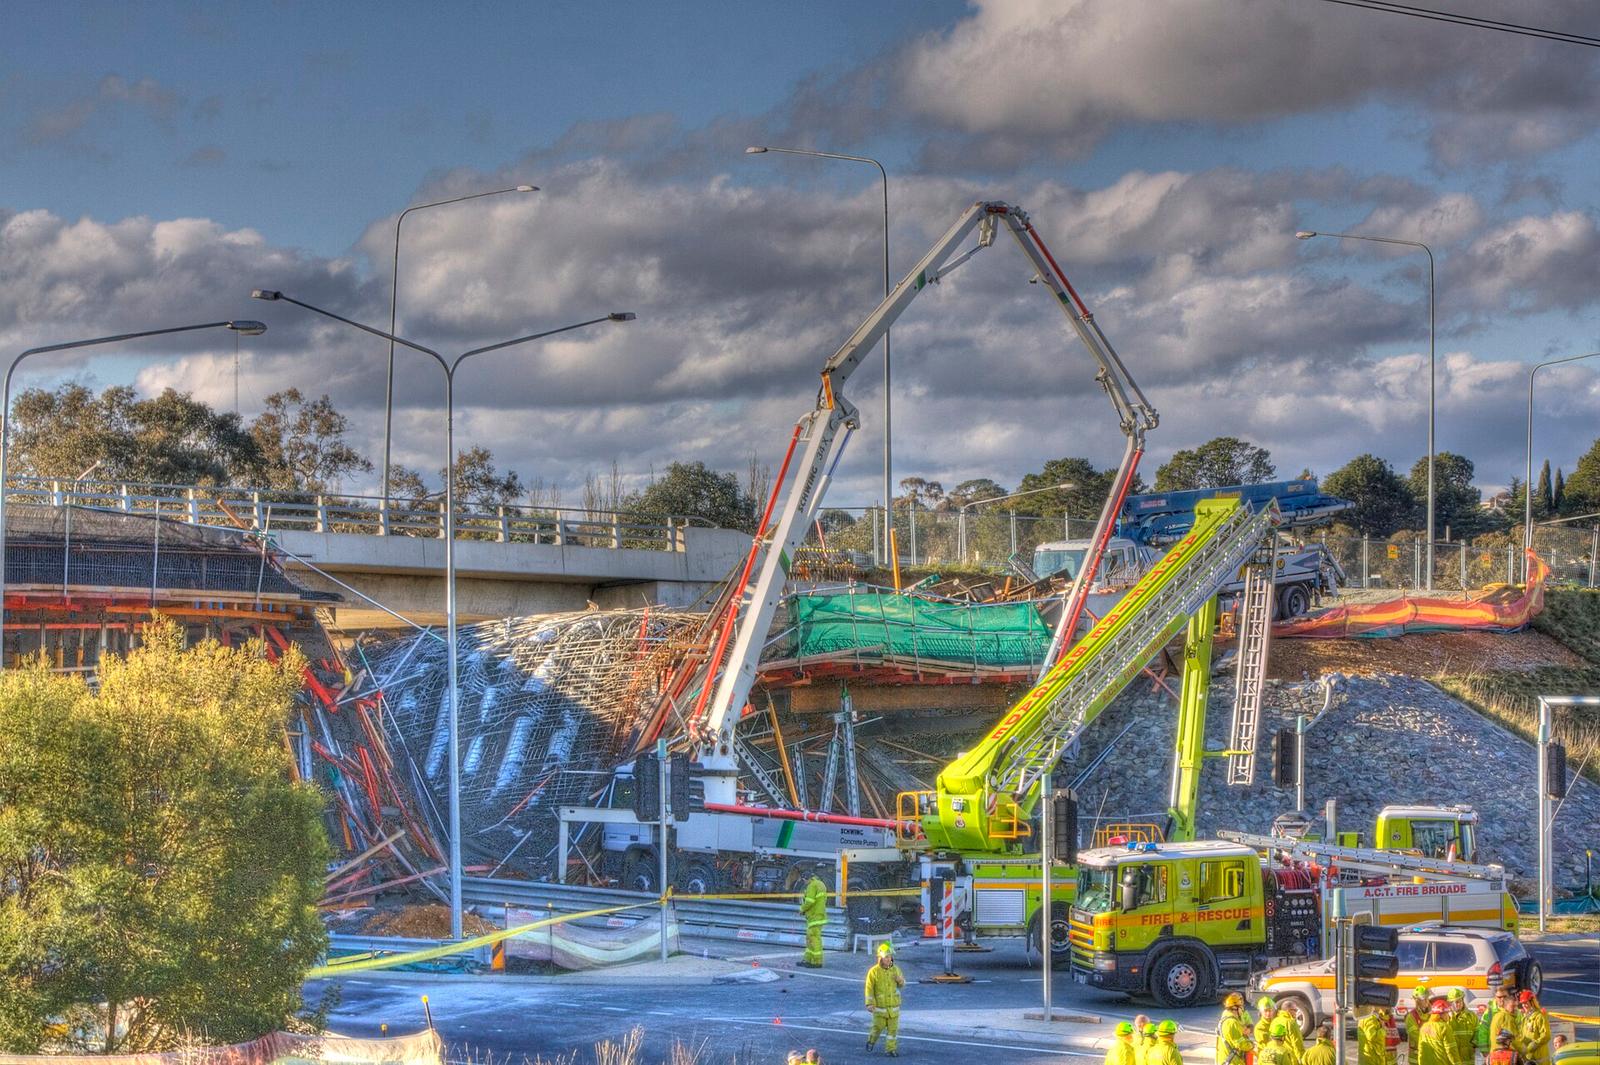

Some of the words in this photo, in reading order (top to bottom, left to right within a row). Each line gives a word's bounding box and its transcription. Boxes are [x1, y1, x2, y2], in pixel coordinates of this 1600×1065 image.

[798, 466, 818, 513] SCHWING
[1090, 588, 1145, 638] FIRE
[1123, 662, 1139, 679] FIRE
[1143, 627, 1171, 659] BRIGADE
[991, 646, 1088, 739] BRIGADE
[840, 828, 863, 836] SCHWING
[840, 837, 862, 846] Concrete
[863, 839, 878, 847] Pump
[1364, 888, 1393, 897] A.C.T.
[1396, 886, 1418, 895] FIRE
[1422, 884, 1467, 895] BRIGADE
[1094, 918, 1115, 928] FIRE
[1141, 914, 1170, 926] FIRE
[1180, 911, 1190, 924] &
[1197, 907, 1250, 921] RESCUE
[1119, 929, 1127, 938] 9
